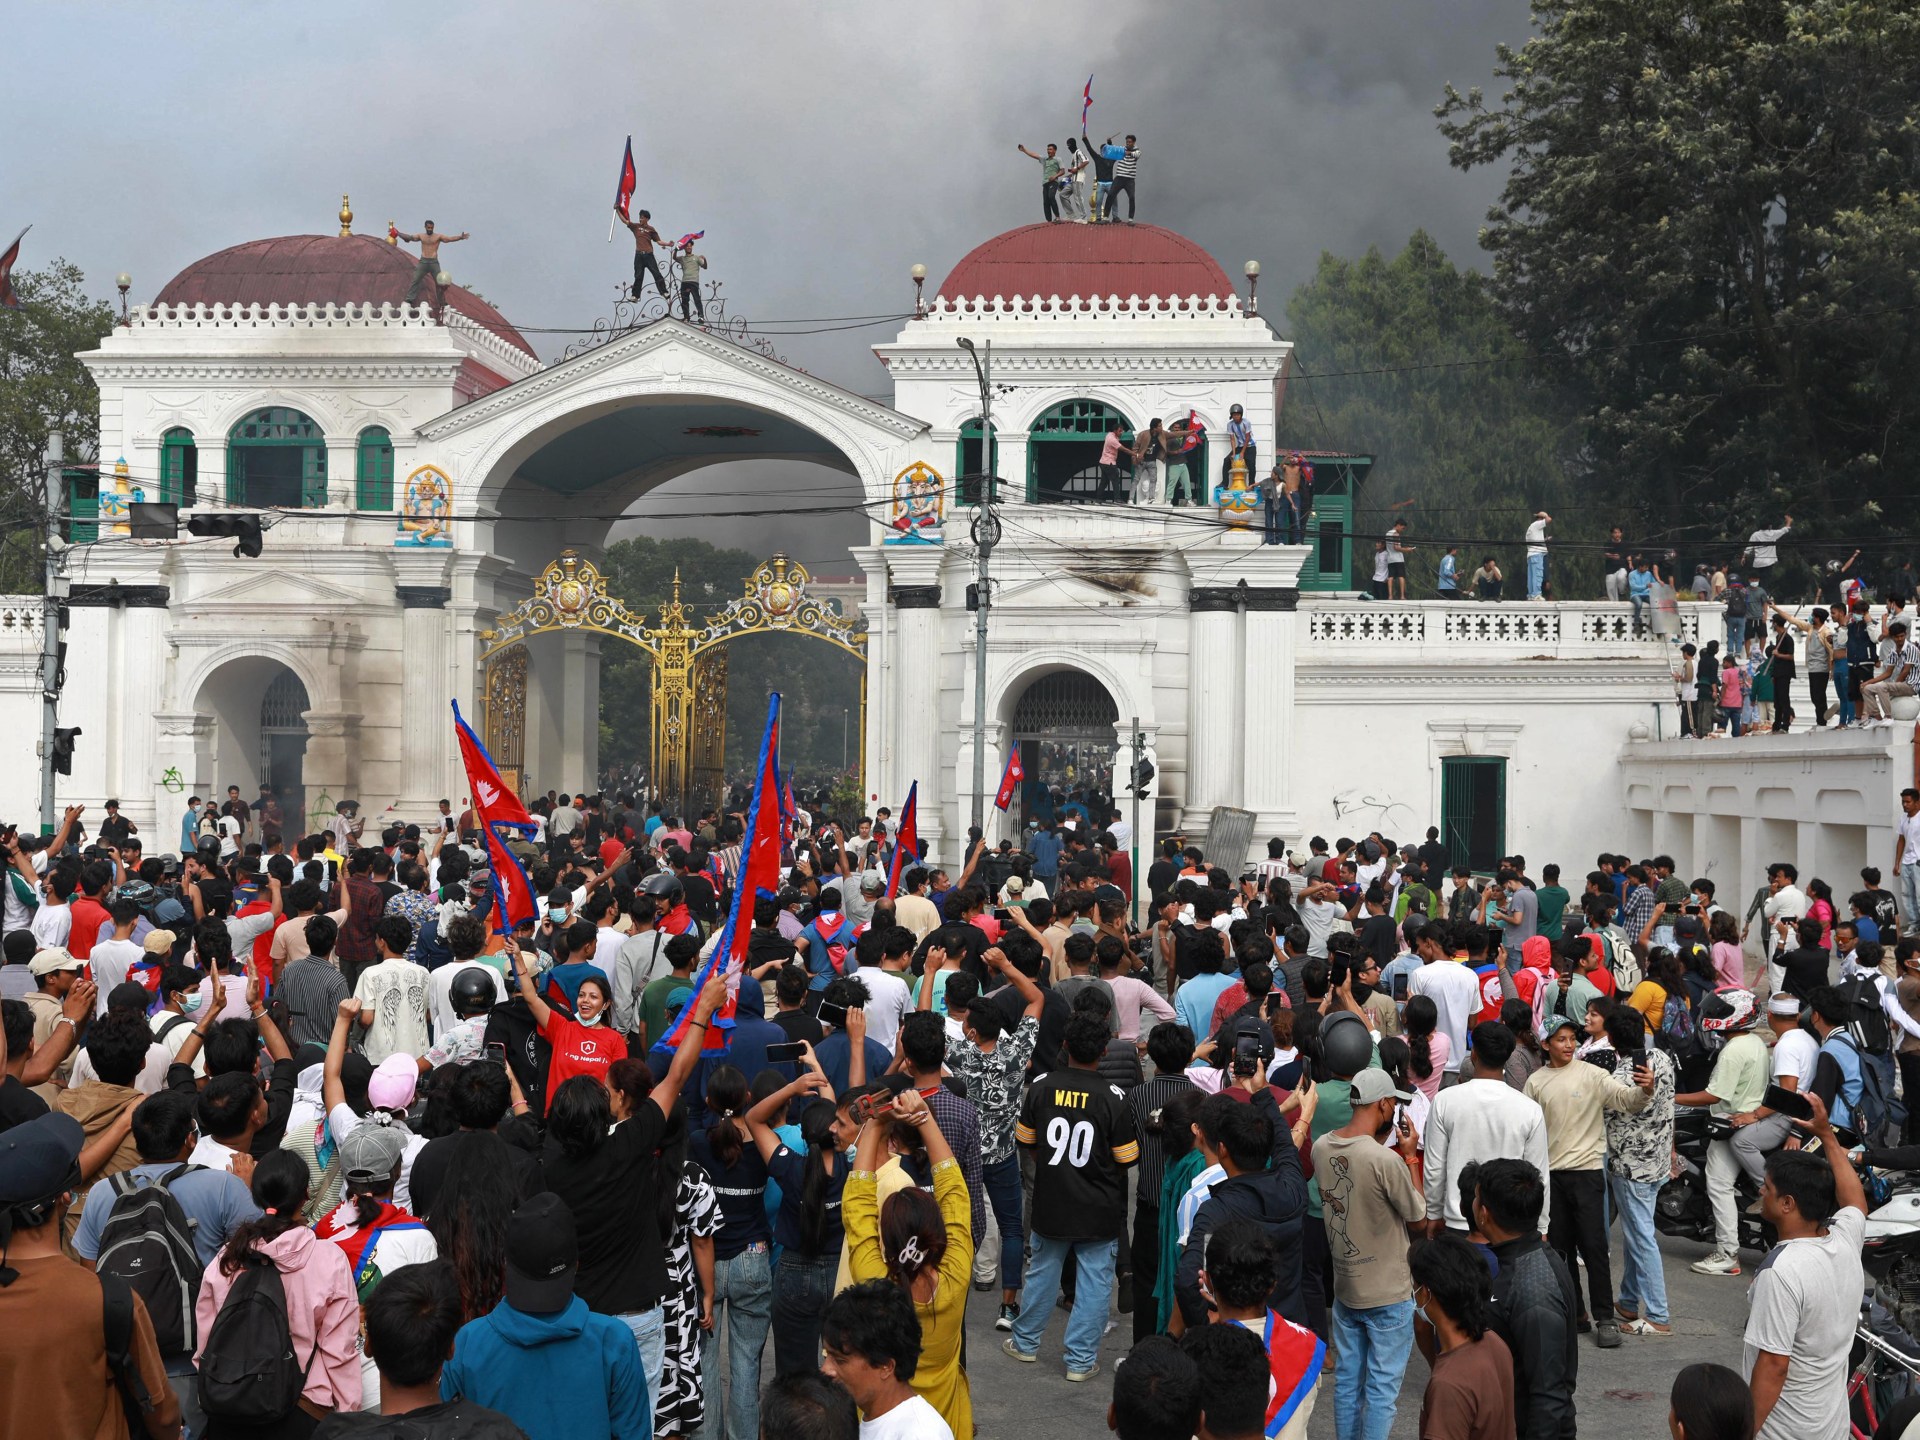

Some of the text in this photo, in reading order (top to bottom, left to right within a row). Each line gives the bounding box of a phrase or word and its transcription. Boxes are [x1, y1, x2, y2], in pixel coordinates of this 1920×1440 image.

[1055, 1089, 1090, 1109] WATT
[1046, 1116, 1095, 1168] 90
[724, 1187, 741, 1196] FREEDOM
[740, 1188, 754, 1196] EQUITY
